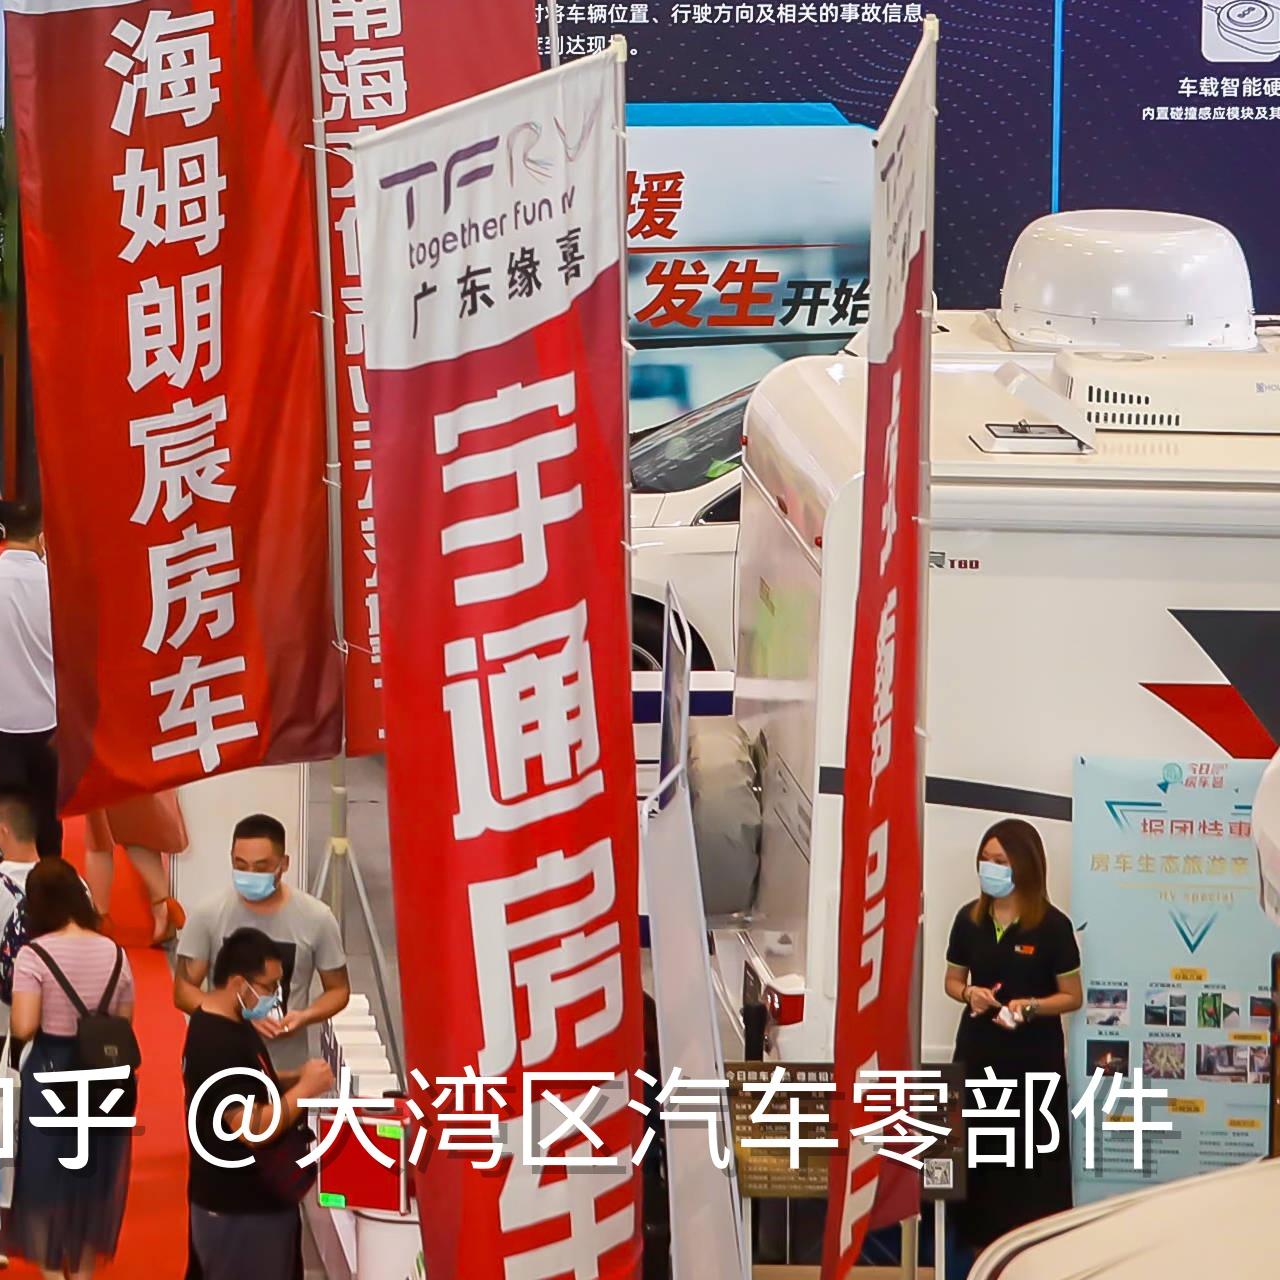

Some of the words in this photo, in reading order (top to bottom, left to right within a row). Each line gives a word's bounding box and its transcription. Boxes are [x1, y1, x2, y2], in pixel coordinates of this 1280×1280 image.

[407, 213, 507, 270] together
[512, 198, 554, 233] fun
[410, 226, 586, 340] 广东缘喜
[102, 8, 259, 775] 海姆朗宸房车
